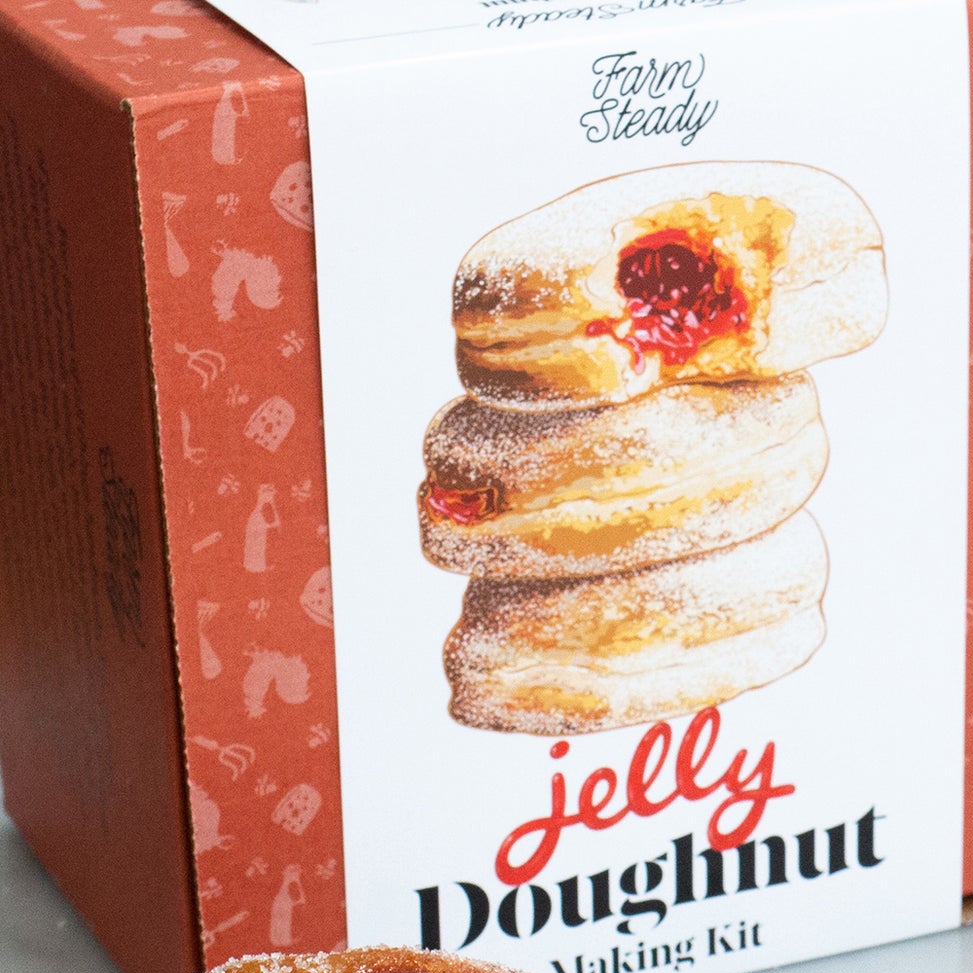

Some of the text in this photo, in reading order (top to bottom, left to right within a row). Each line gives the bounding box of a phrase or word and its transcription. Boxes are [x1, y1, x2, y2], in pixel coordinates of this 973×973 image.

[487, 4, 635, 29] Steady
[592, 50, 705, 99] Farm
[579, 88, 718, 147] Steady
[494, 706, 796, 887] jelly
[414, 805, 887, 951] Doughnut
[707, 920, 764, 957] Kit
